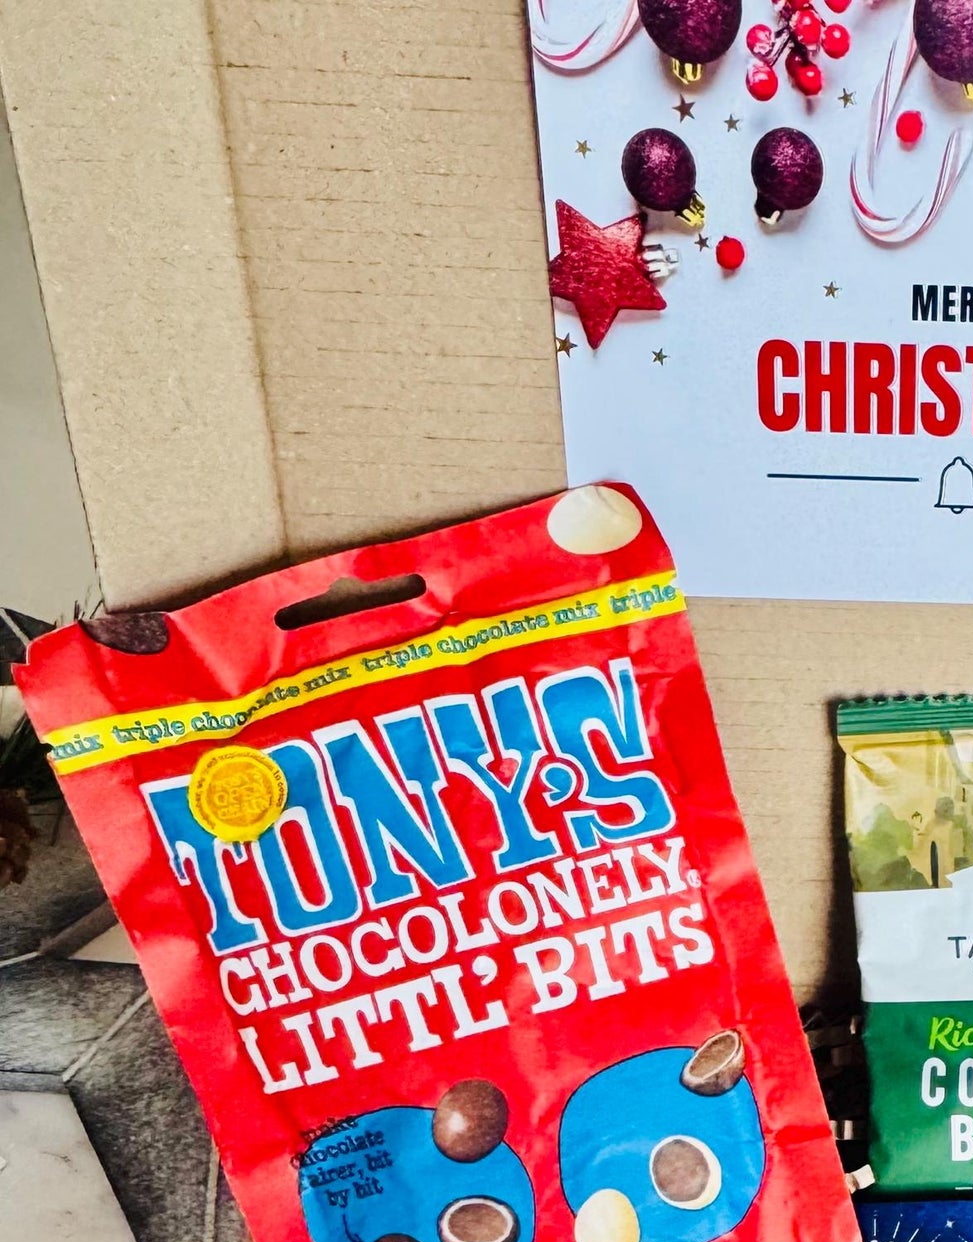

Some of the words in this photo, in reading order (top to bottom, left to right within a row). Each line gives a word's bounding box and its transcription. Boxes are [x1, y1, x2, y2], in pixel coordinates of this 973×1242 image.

[51, 732, 105, 762] mix
[112, 717, 186, 744] triple
[303, 665, 353, 691] mix
[361, 639, 433, 670] triple
[436, 613, 549, 654] chocolate
[553, 600, 600, 625] mix
[609, 583, 677, 613] triple
[140, 657, 677, 957] TONY'S
[239, 957, 509, 1095] LITTL'
[514, 903, 715, 1015] BITS
[326, 1187, 350, 1208] by
[353, 1177, 384, 1199] bit
[365, 1149, 394, 1172] bit
